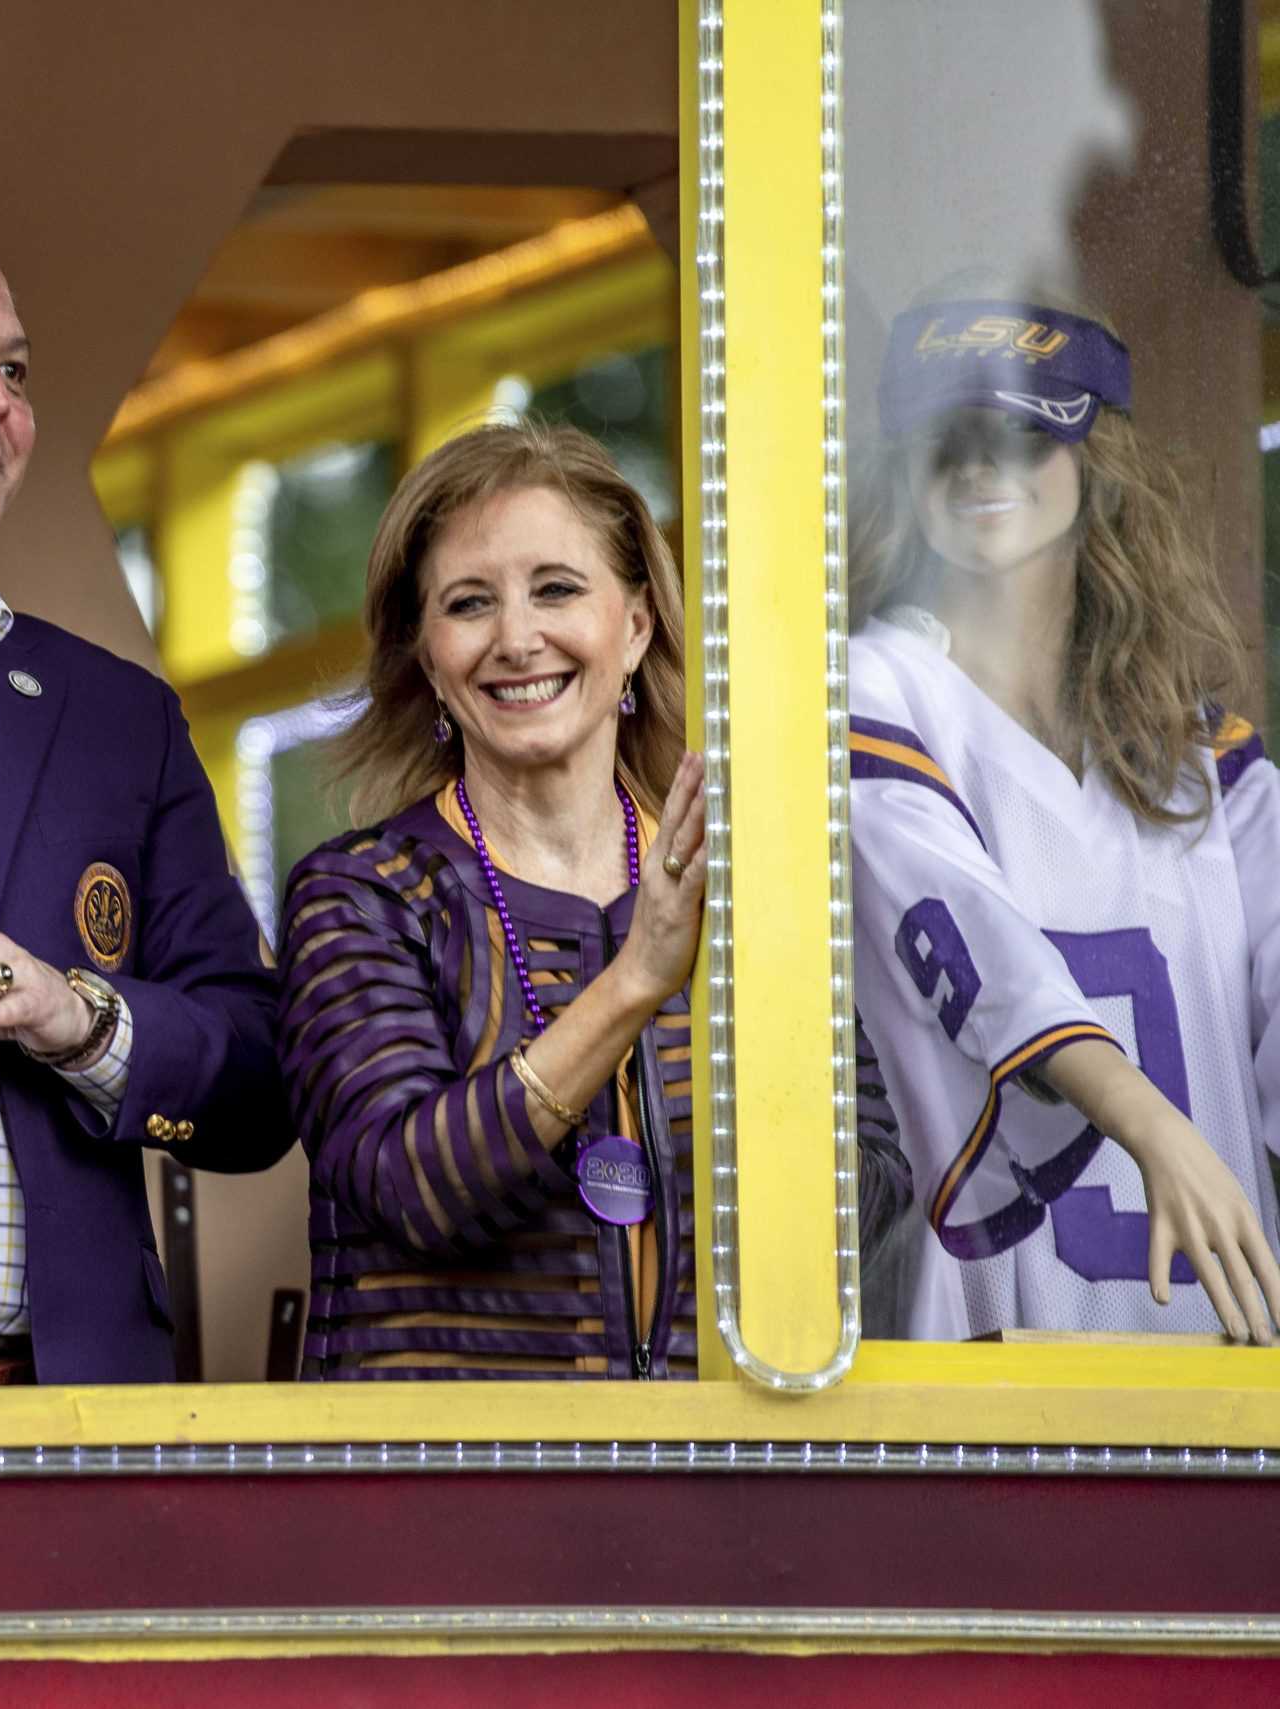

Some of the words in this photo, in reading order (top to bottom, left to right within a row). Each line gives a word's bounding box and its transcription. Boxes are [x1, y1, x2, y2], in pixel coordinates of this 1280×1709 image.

[914, 315, 1069, 359] LSU
[894, 897, 982, 1042] 9
[586, 1156, 651, 1187] 2020
